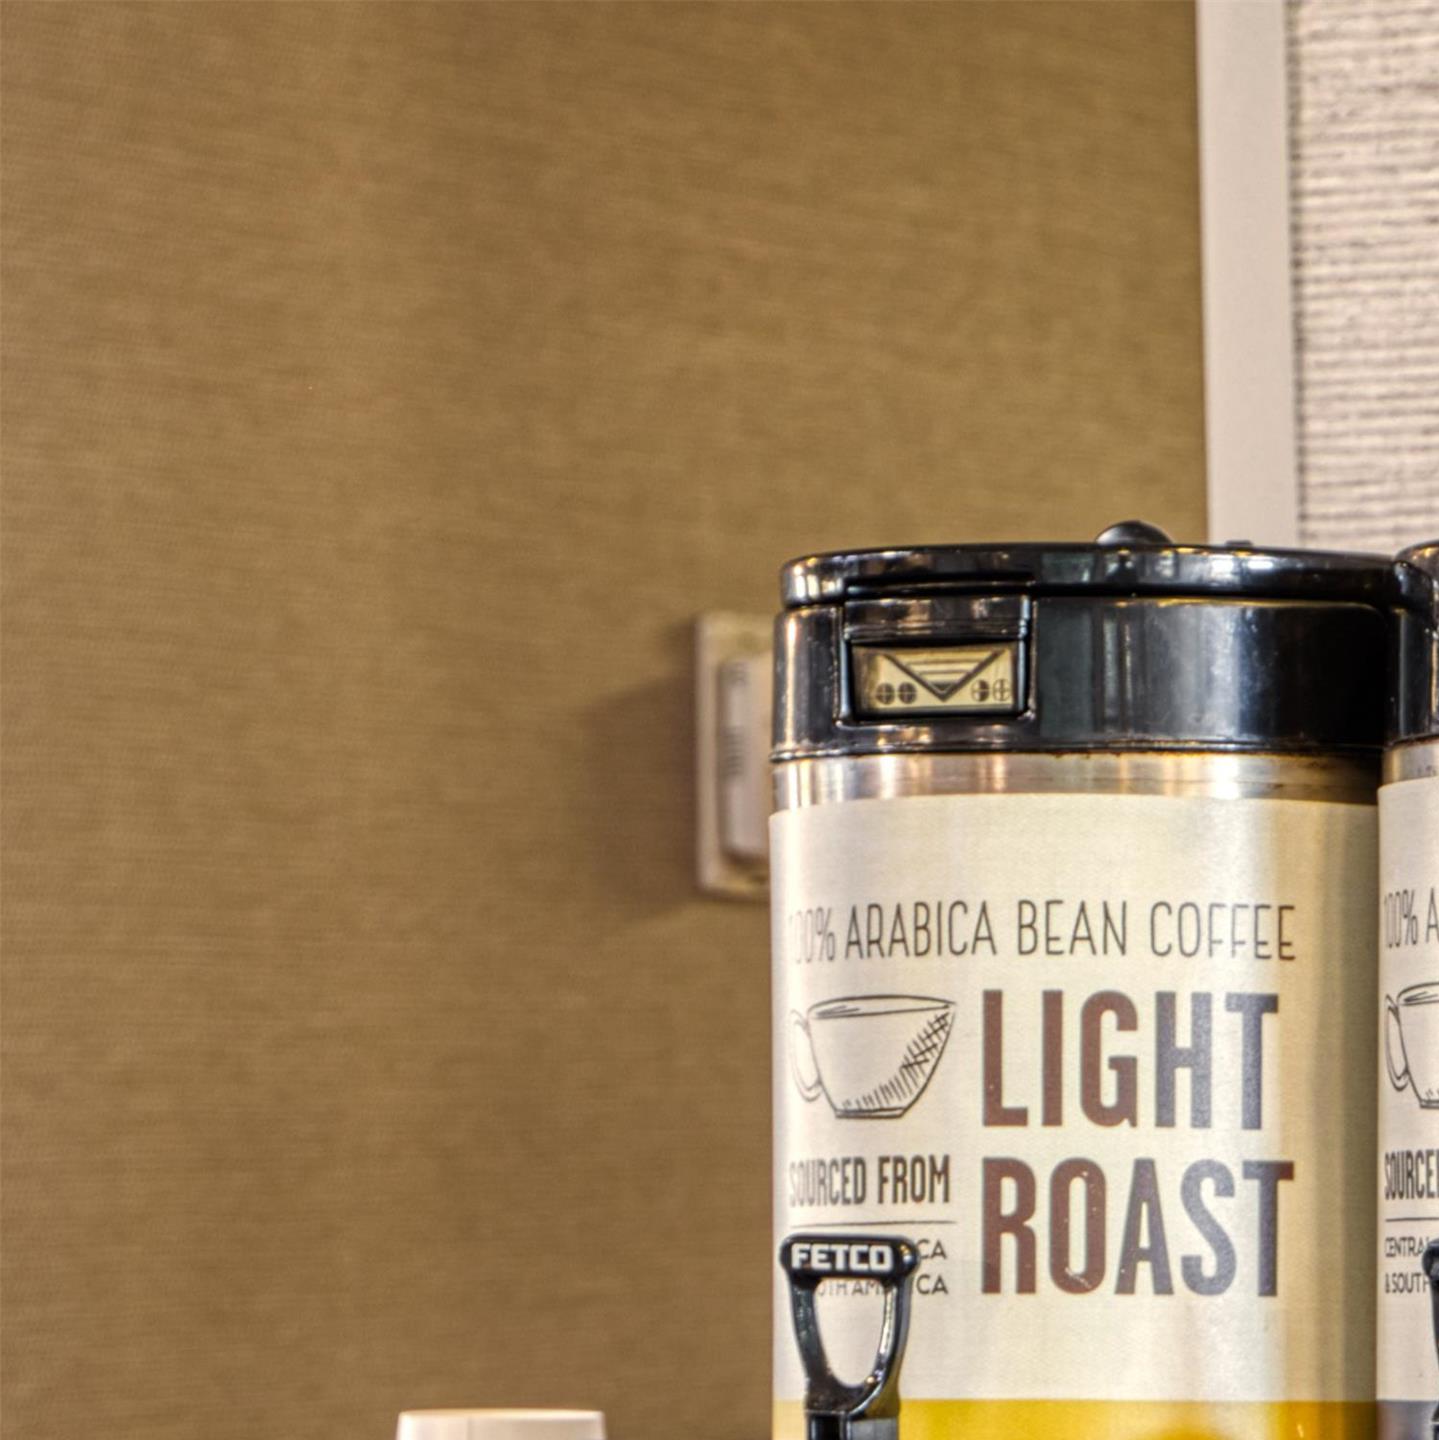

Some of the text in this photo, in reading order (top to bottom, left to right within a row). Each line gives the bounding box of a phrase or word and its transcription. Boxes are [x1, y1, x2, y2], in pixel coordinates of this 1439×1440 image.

[845, 900, 998, 960] ARABICA
[1016, 901, 1127, 956] BEAN
[1150, 901, 1297, 961] COFFEE
[982, 989, 1280, 1131] LIGHT
[877, 1154, 950, 1205] FROM
[790, 1242, 894, 1272] FETCO
[981, 1157, 1296, 1298] ROAST
